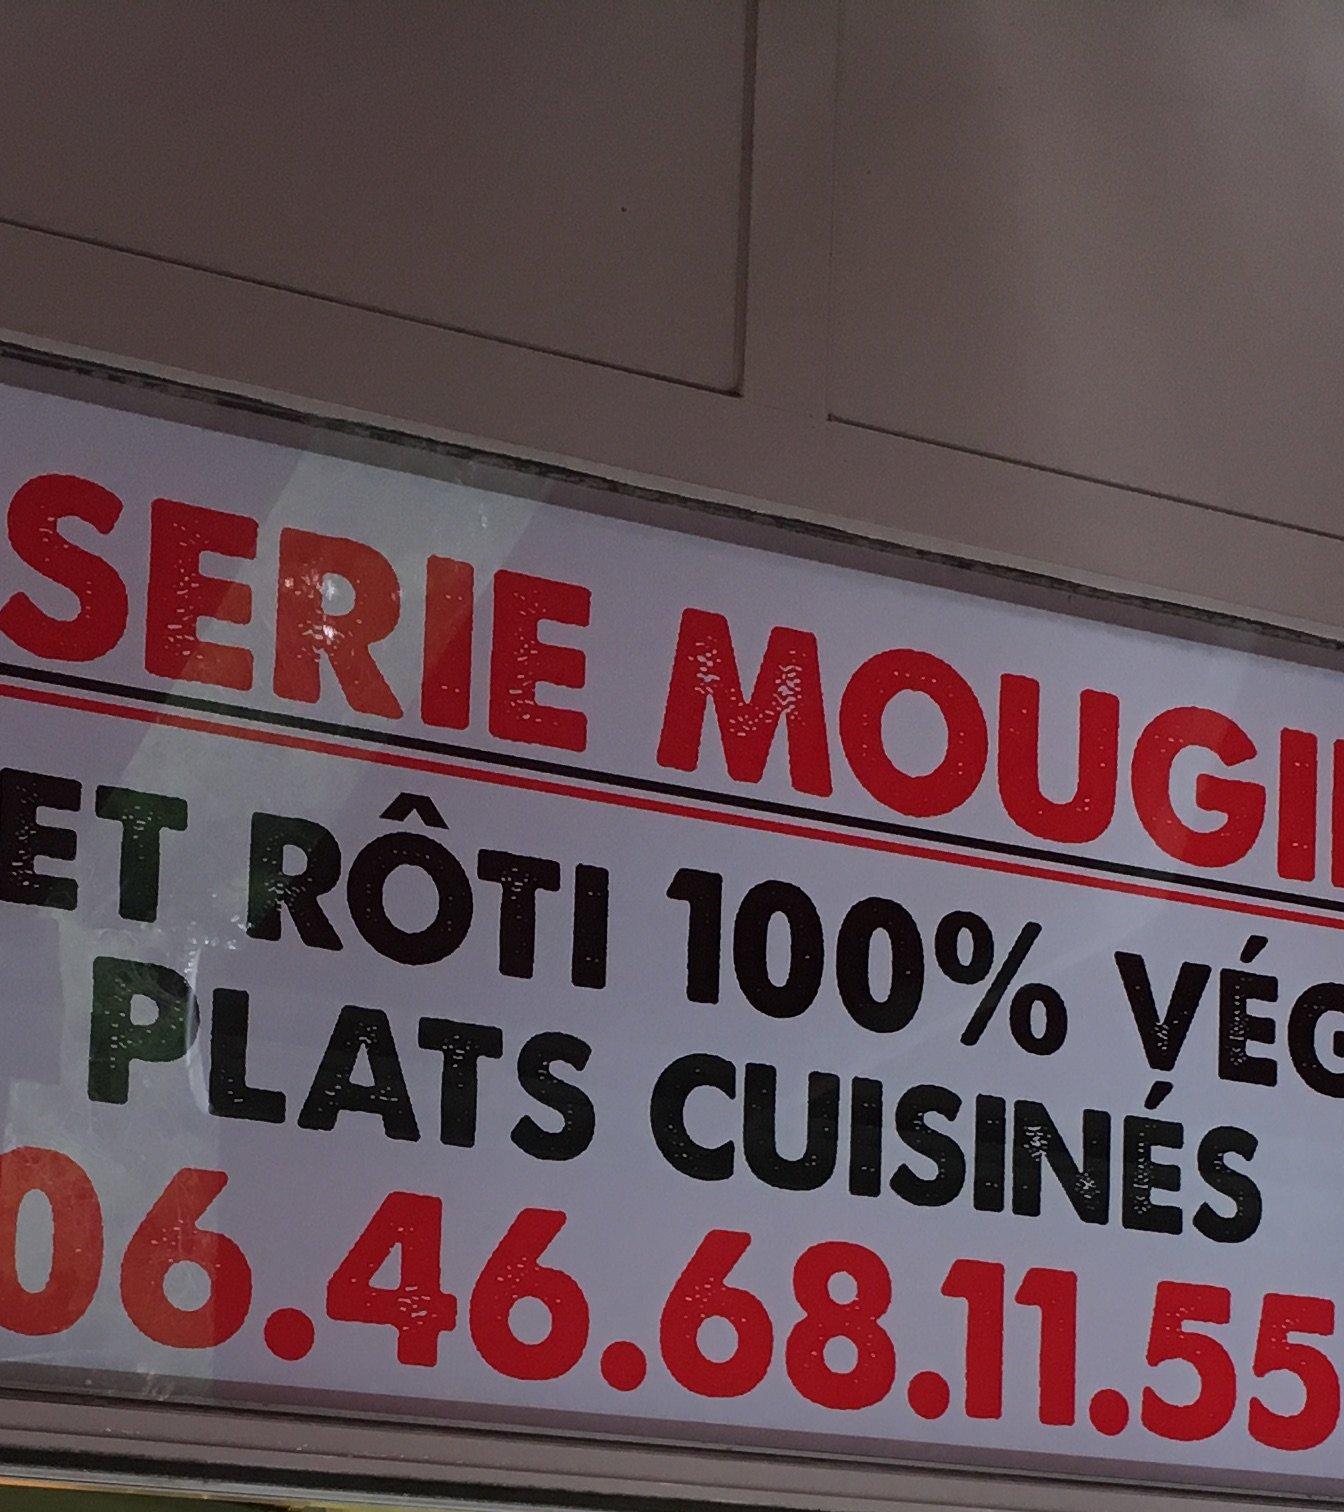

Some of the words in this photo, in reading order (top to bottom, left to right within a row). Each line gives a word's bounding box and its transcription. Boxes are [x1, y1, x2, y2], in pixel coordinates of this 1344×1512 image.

[245, 791, 610, 989] RÔTI
[666, 866, 1070, 1056] 100%
[87, 955, 596, 1161] PLATS
[649, 1053, 1264, 1244] CUISINÉS
